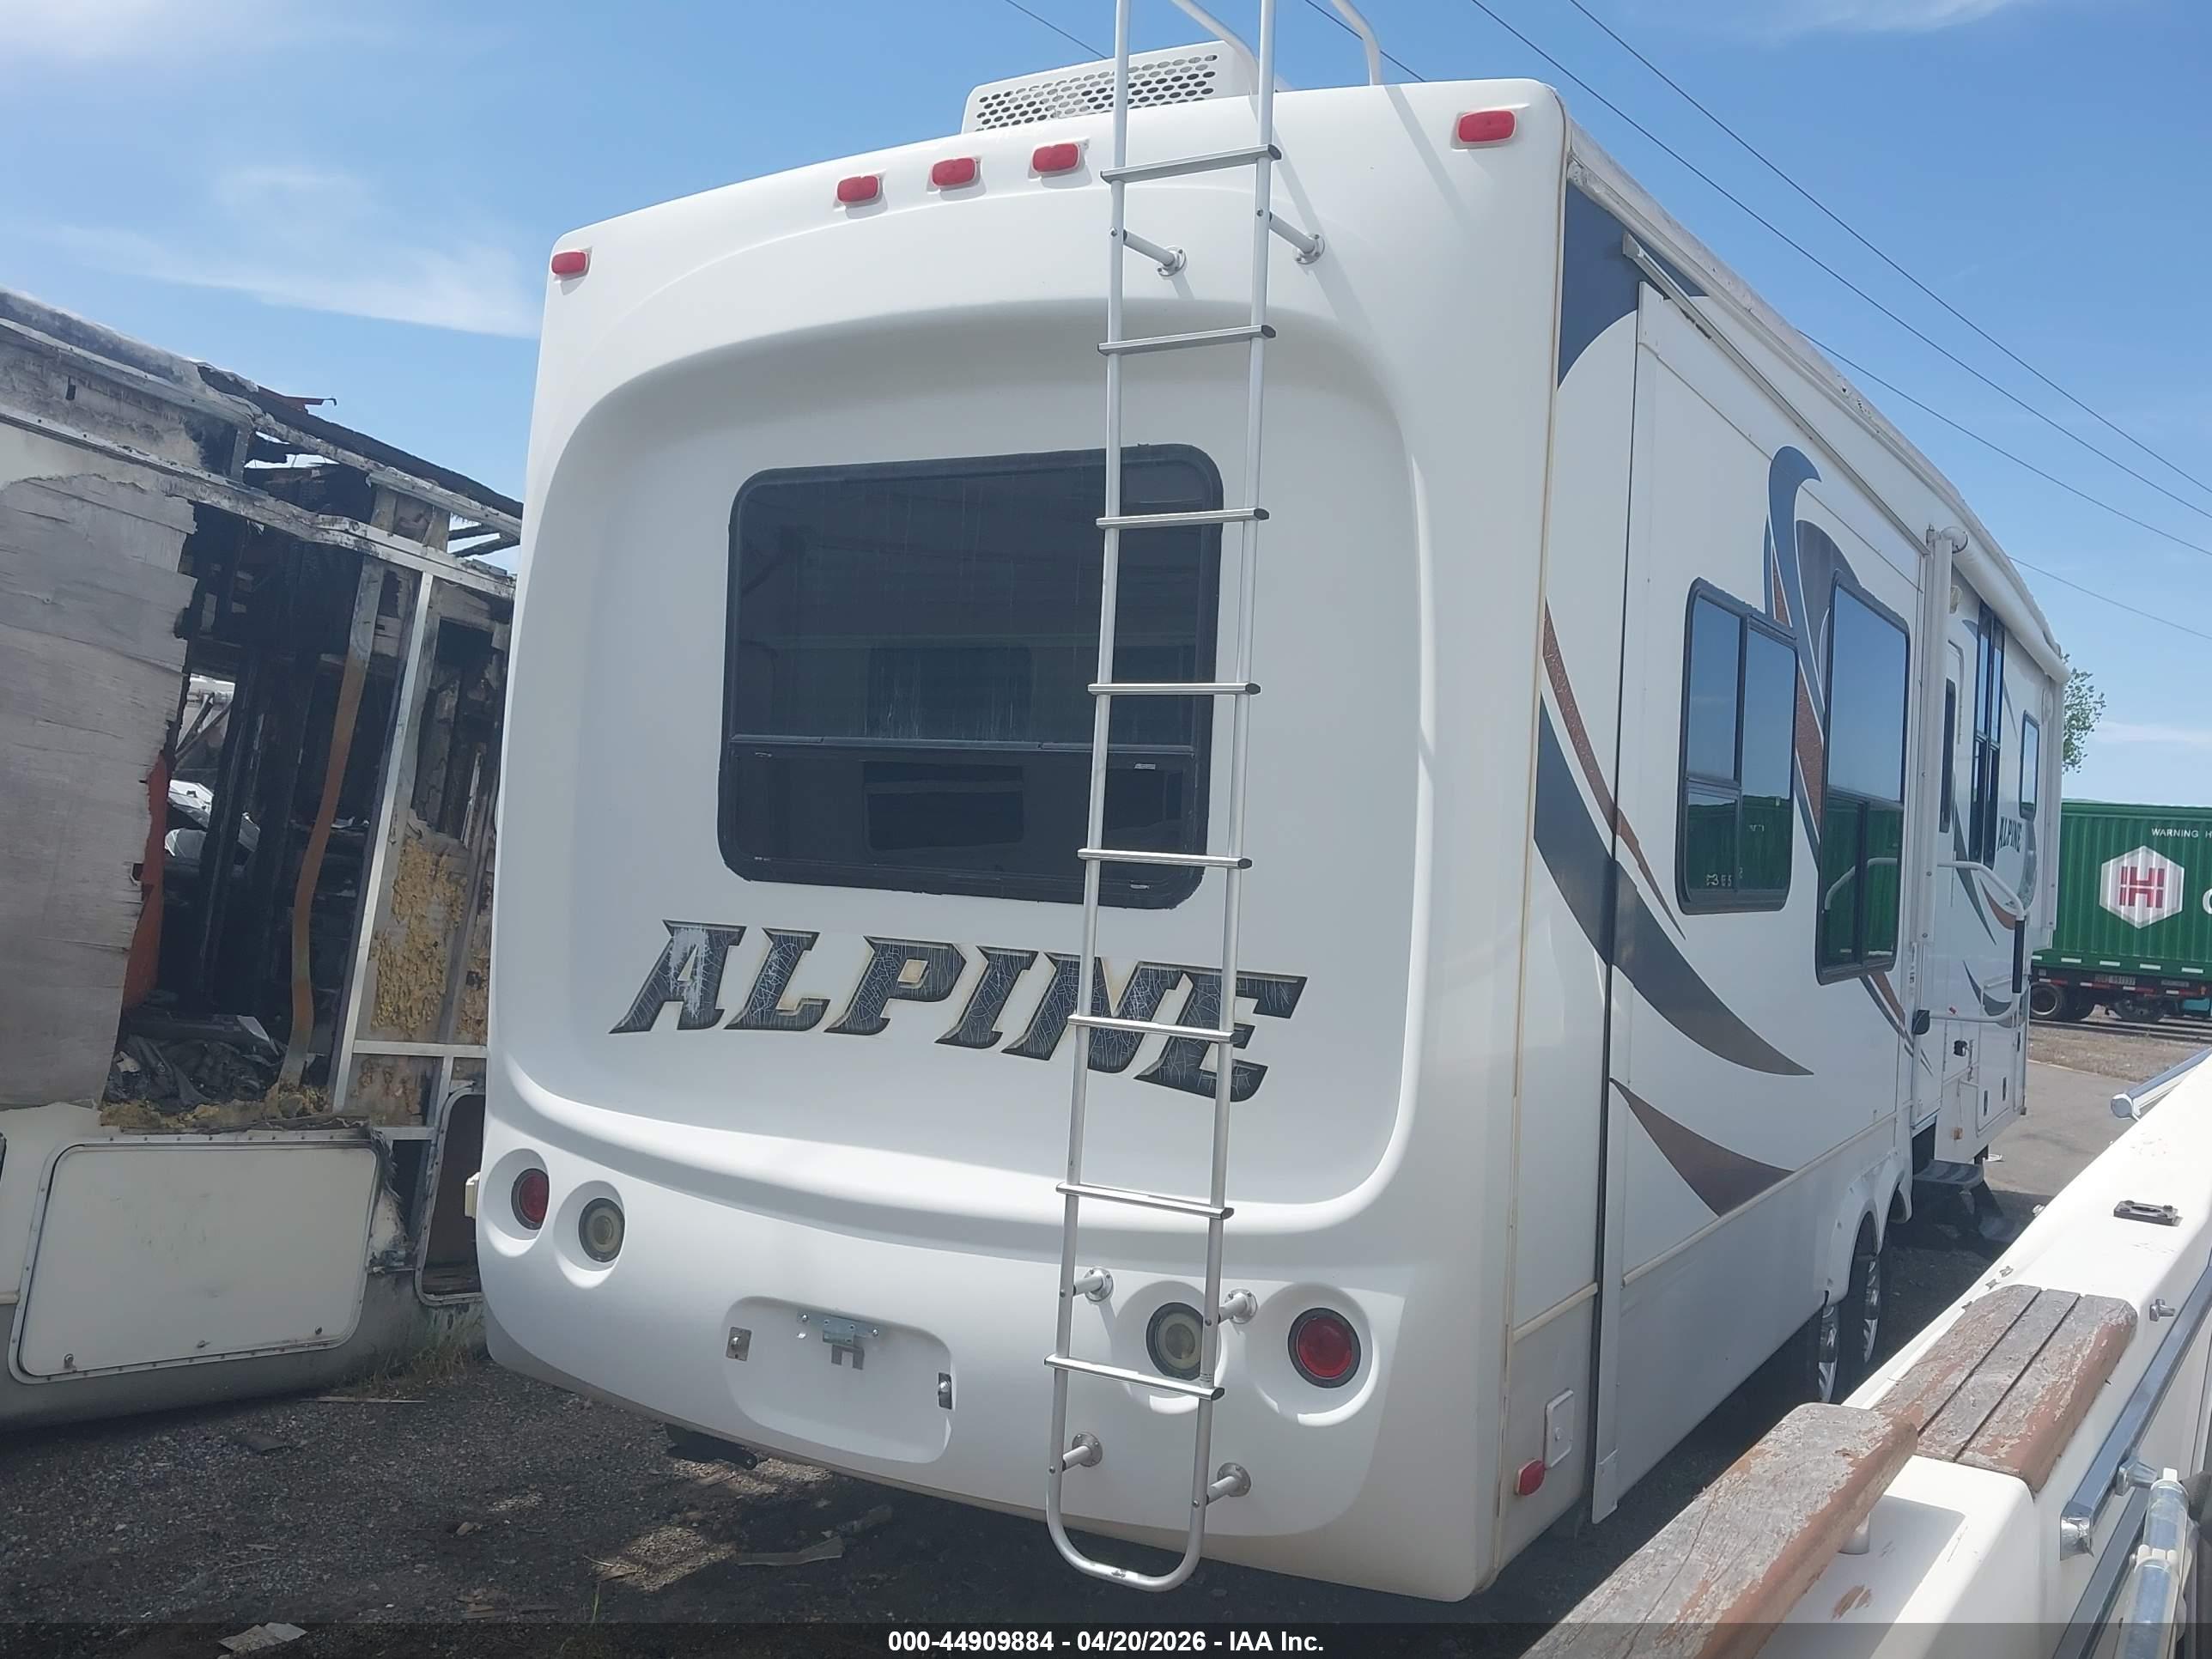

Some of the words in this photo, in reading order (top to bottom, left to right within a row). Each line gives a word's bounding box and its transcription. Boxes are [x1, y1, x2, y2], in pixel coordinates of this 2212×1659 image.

[1996, 816, 2022, 854] ALPINE
[2151, 828, 2199, 838] WARNING
[608, 918, 1309, 1103] ALPINE
